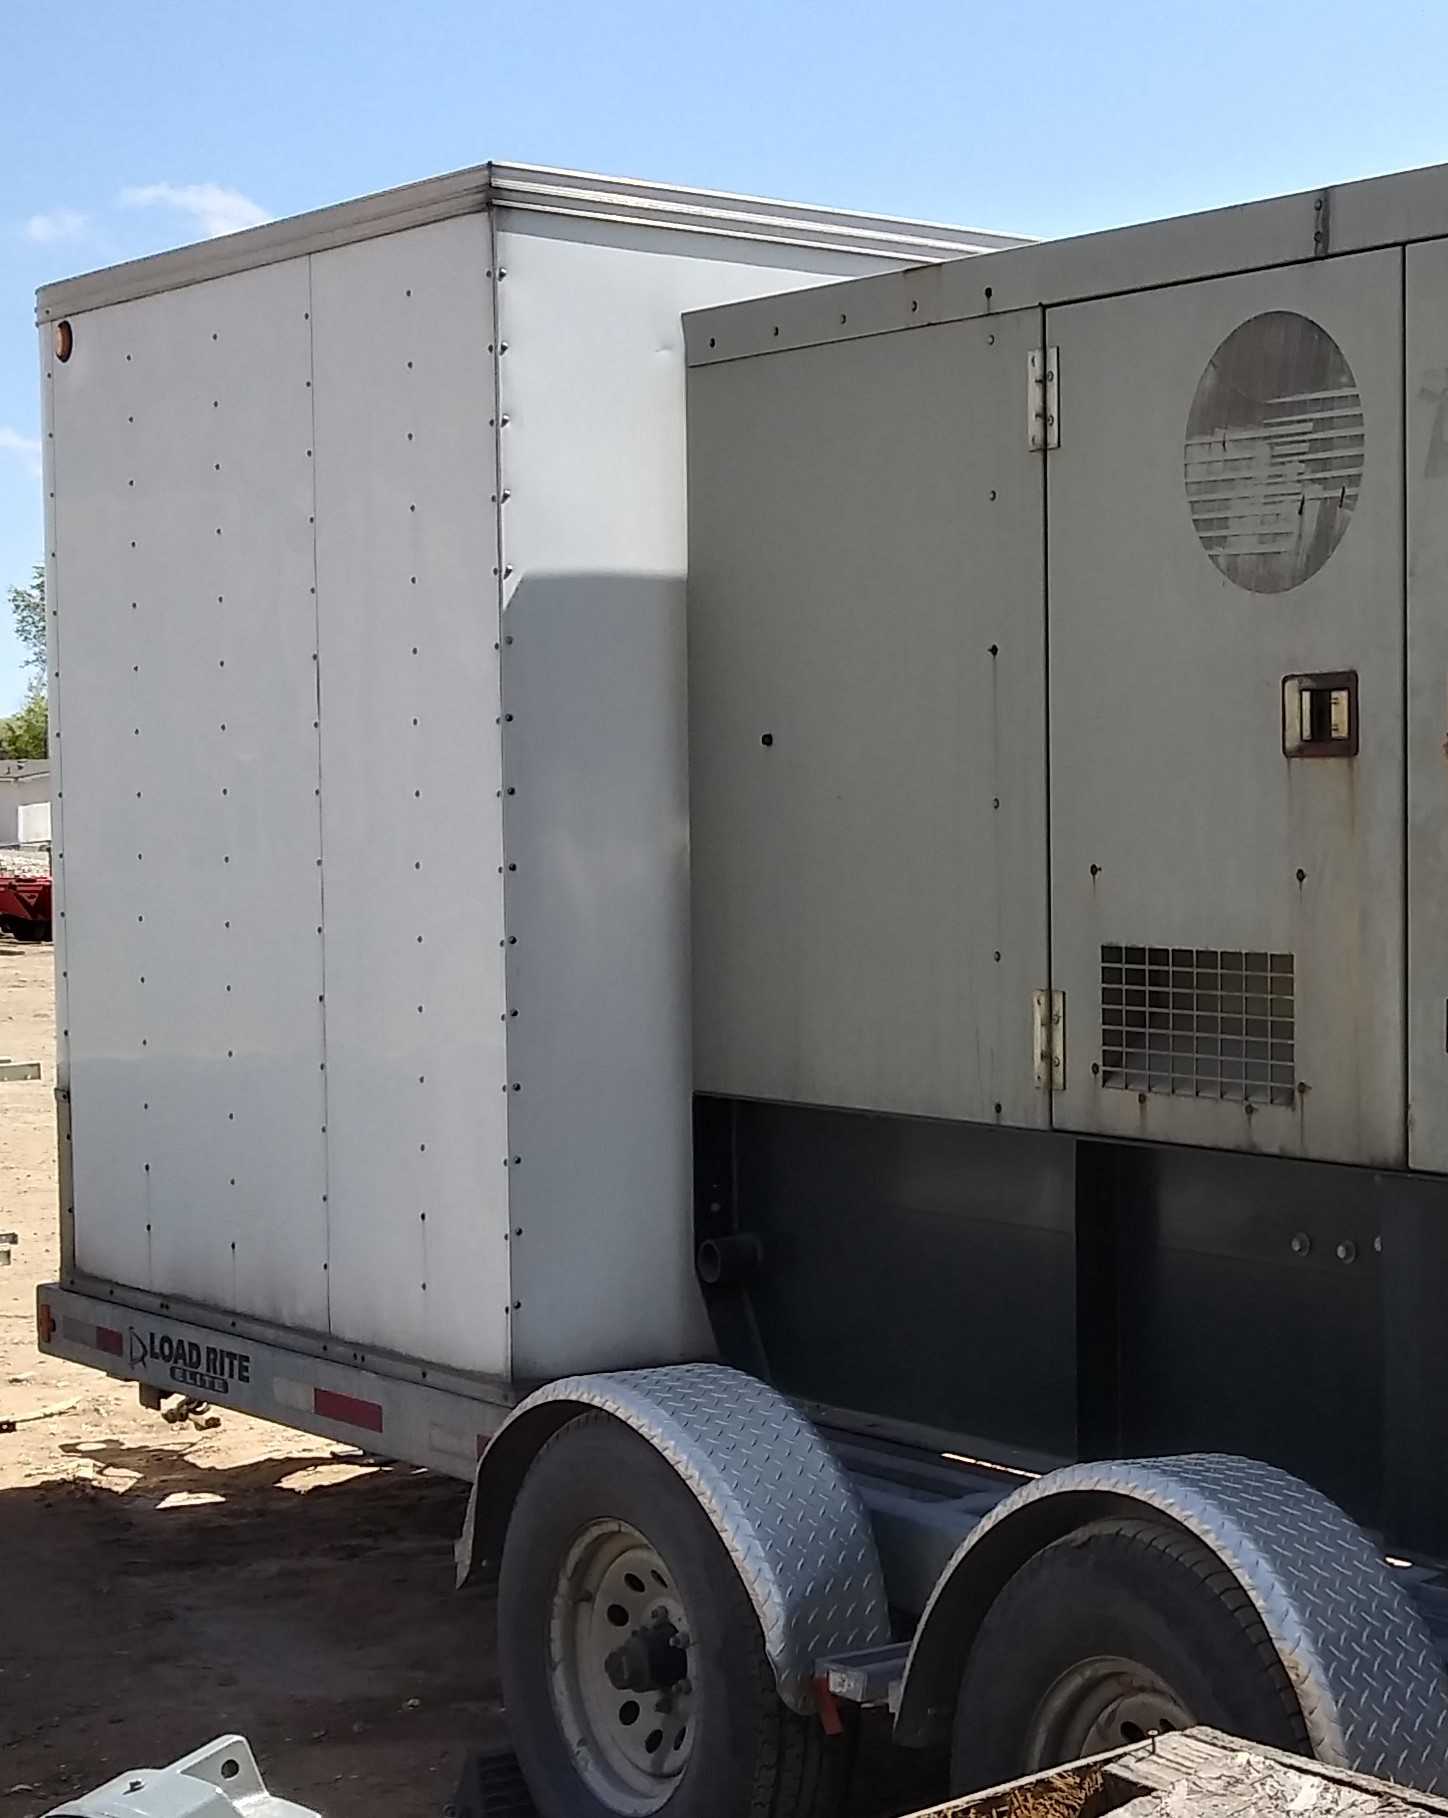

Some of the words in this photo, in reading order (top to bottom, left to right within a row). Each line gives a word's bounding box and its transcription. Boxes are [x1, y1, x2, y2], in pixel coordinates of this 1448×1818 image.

[150, 1332, 201, 1369] LOAD
[206, 1346, 250, 1383] RITE
[175, 1369, 225, 1391] ELITE
